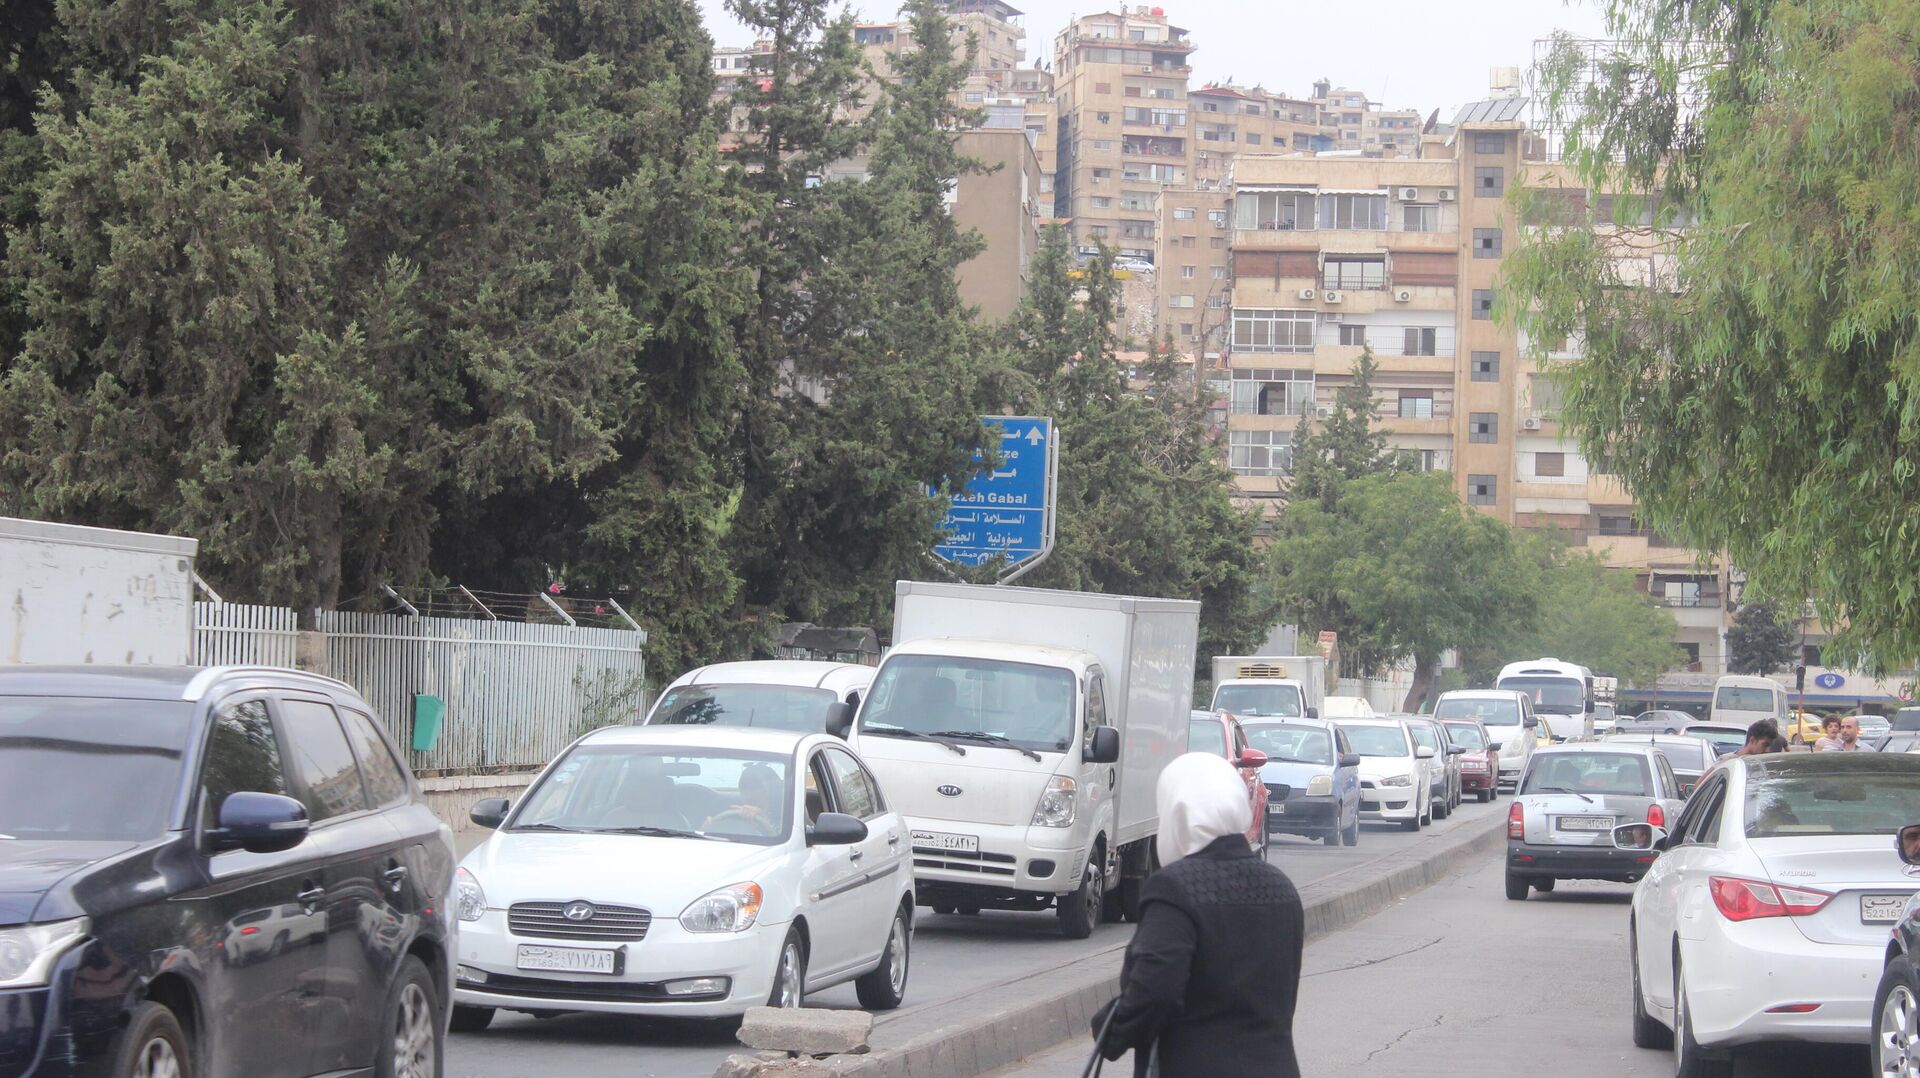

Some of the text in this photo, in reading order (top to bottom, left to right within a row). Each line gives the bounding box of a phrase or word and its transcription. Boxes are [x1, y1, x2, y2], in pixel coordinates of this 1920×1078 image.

[987, 492, 1027, 504] Gabal
[982, 512, 1025, 525] السلامة
[986, 531, 1023, 546] مسؤولية
[940, 786, 958, 794] KIA
